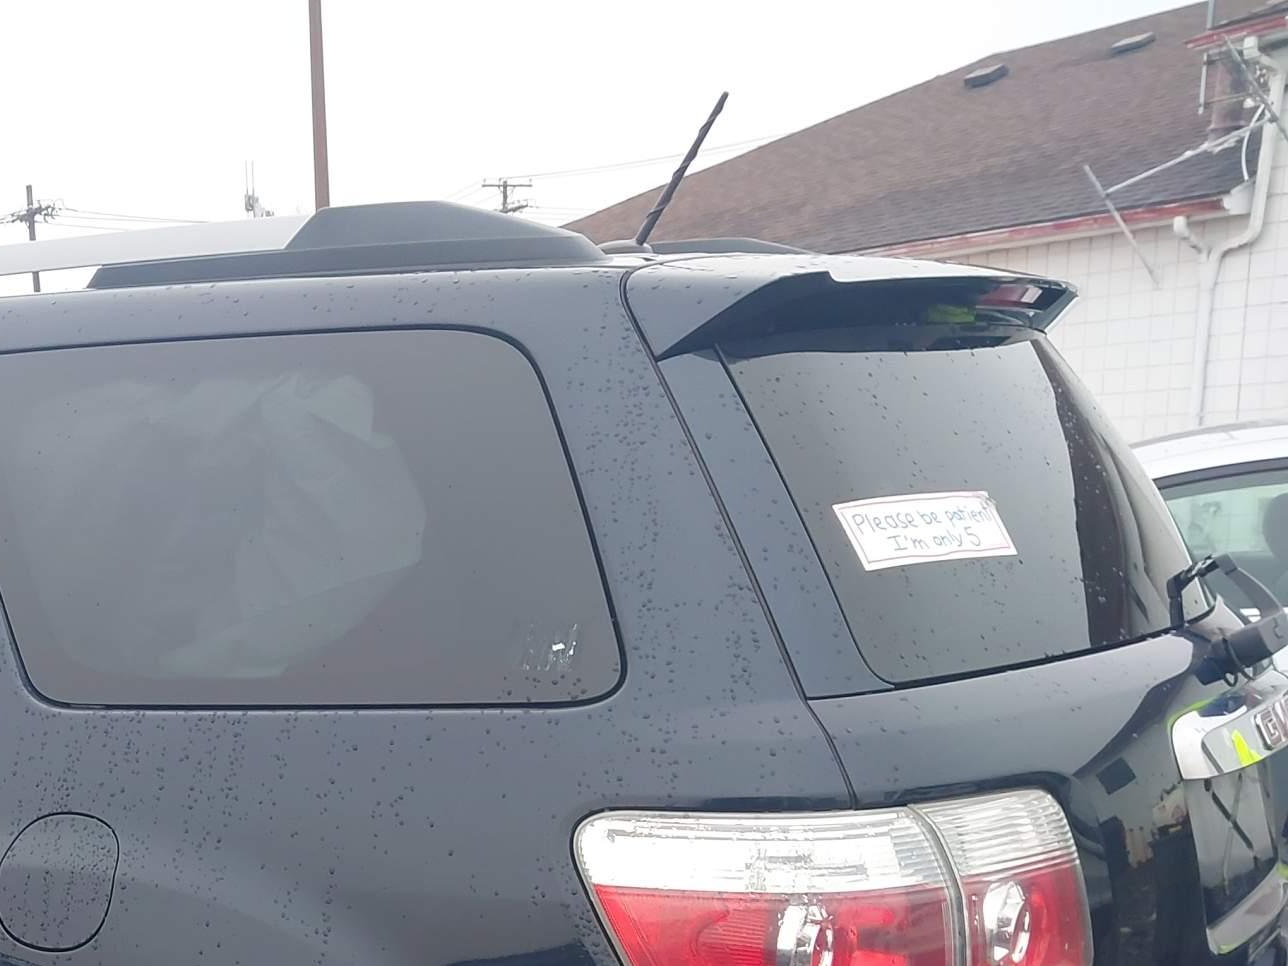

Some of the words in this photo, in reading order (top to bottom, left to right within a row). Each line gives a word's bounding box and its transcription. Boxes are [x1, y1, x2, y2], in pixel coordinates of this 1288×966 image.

[852, 509, 916, 535] Please
[918, 510, 942, 525] be
[887, 533, 928, 551] I'm
[935, 528, 963, 547] only
[966, 526, 981, 547] 5
